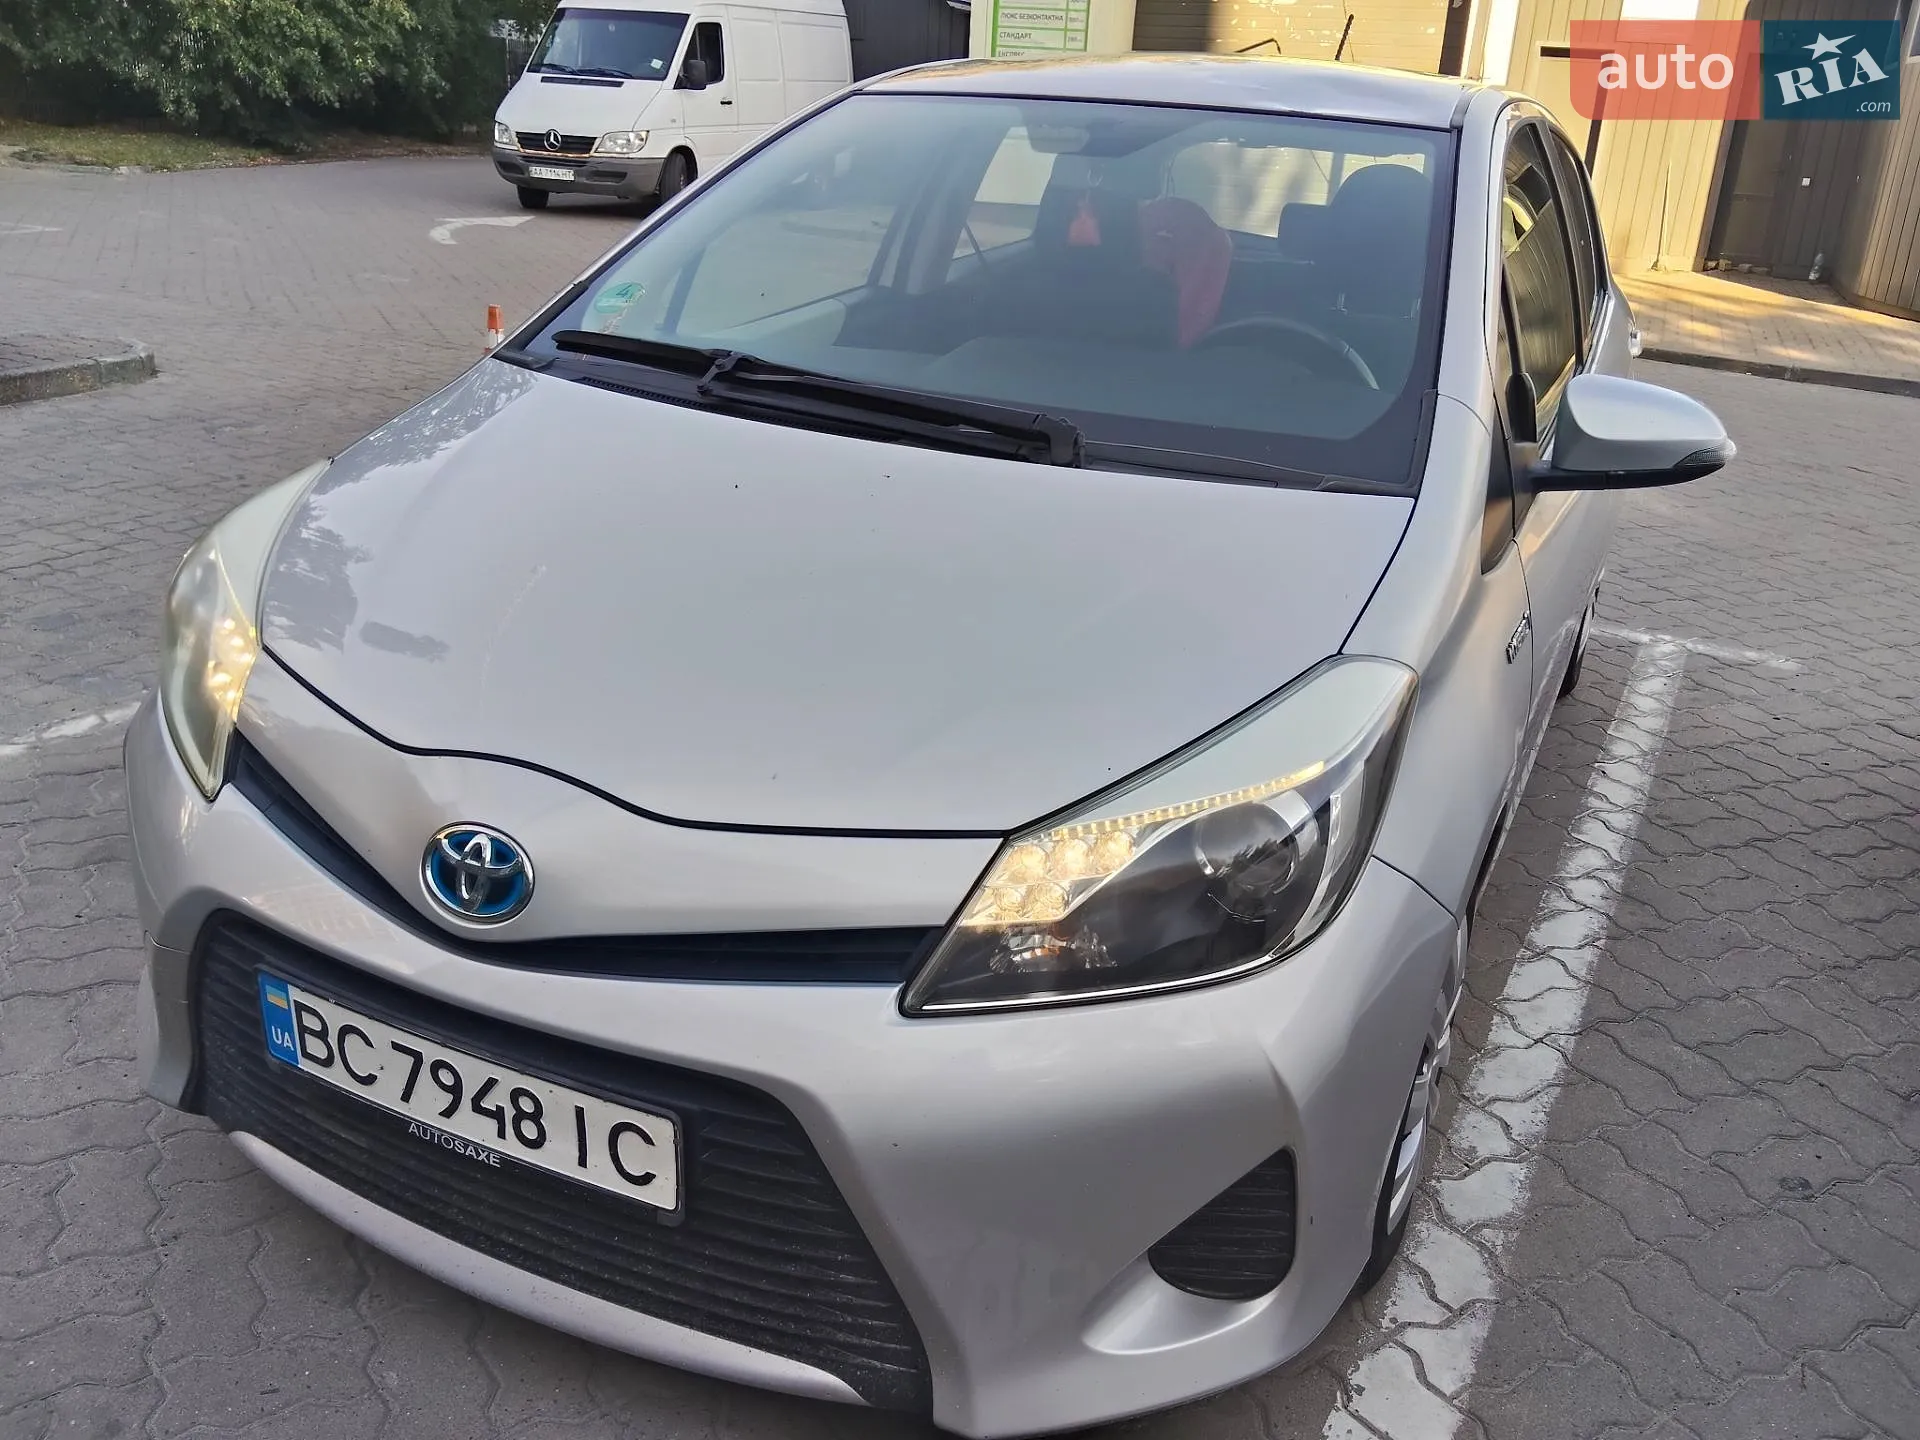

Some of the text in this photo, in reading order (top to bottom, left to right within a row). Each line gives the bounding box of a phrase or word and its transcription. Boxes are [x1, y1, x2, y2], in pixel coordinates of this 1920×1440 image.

[271, 1025, 295, 1051] UA
[294, 999, 657, 1187] BC 7948 IC
[409, 1122, 501, 1168] AUTOSAXE
